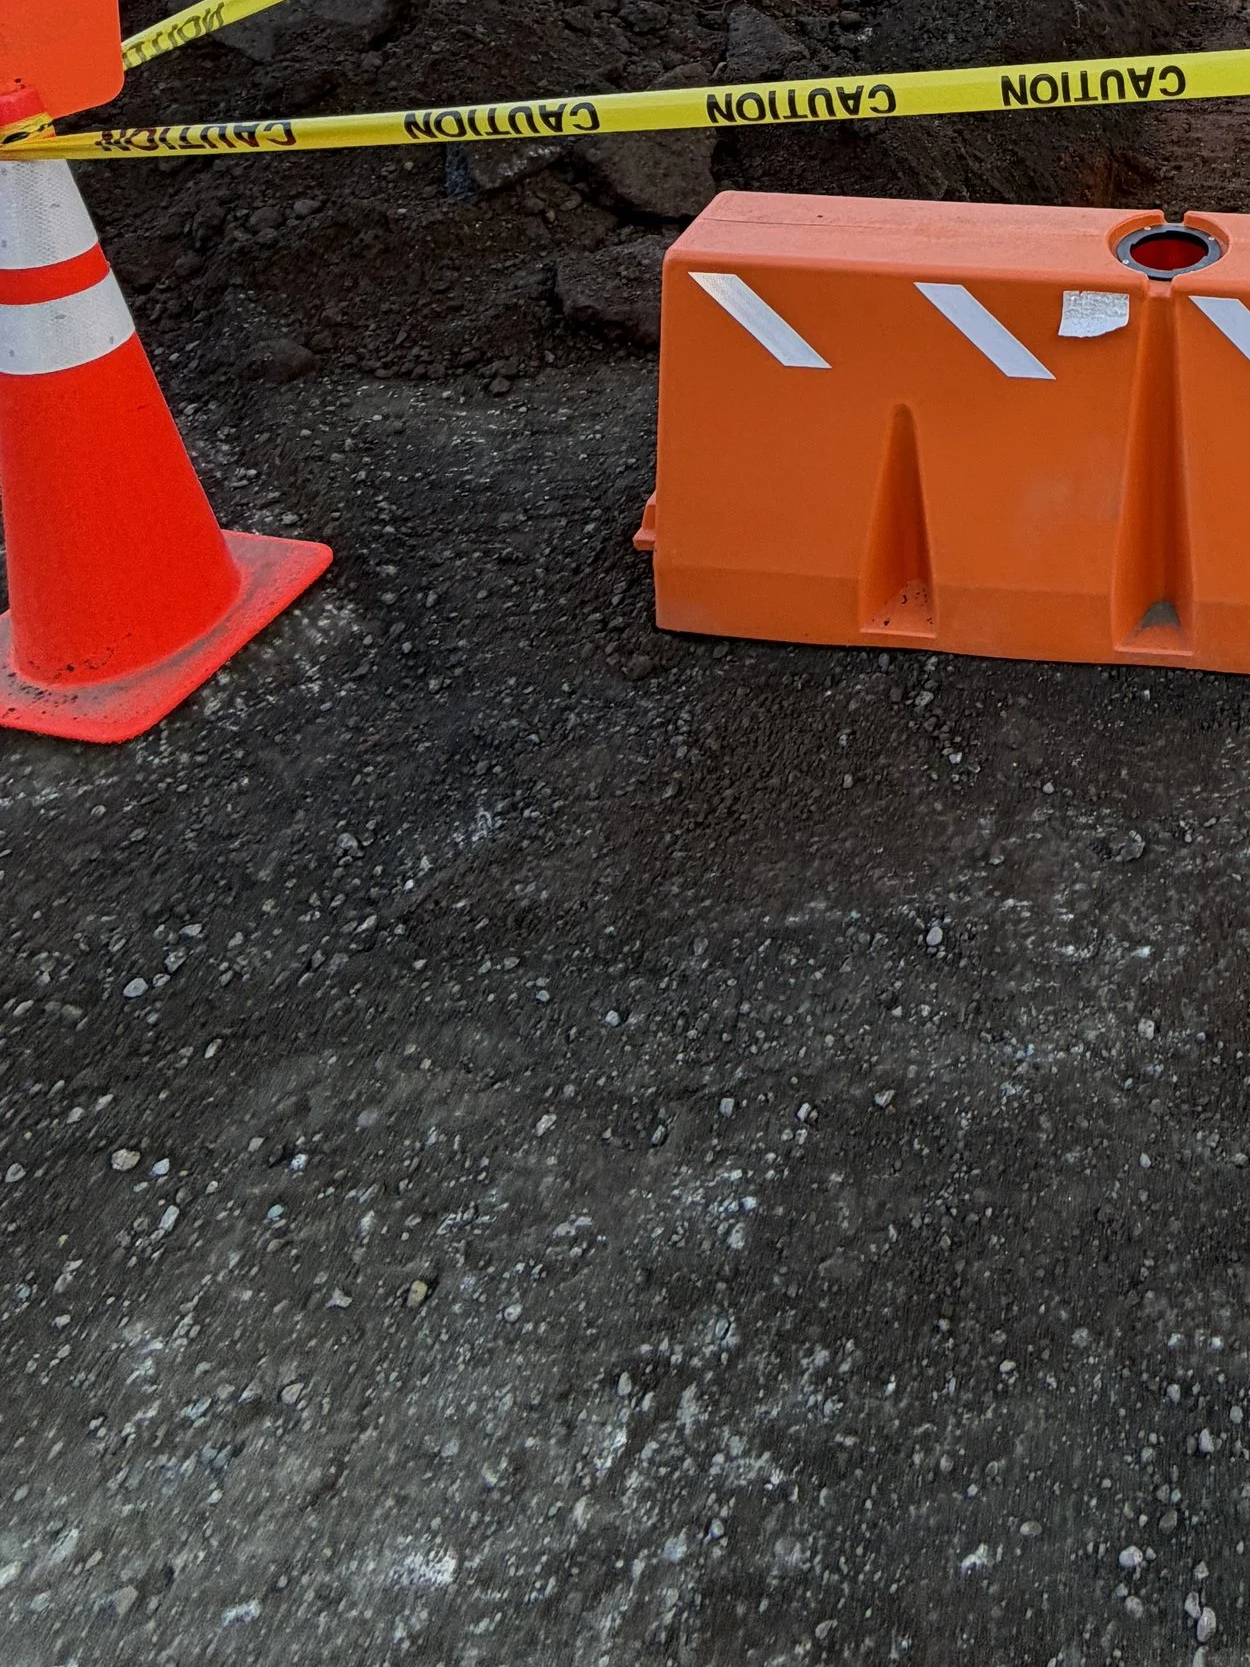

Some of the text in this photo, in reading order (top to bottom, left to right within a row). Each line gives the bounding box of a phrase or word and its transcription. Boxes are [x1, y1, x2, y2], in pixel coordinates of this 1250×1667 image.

[706, 82, 897, 125] CAUTION
[1001, 64, 1187, 108] CAUTION
[95, 120, 297, 153] CAUTION
[403, 100, 601, 141] CAUTION
